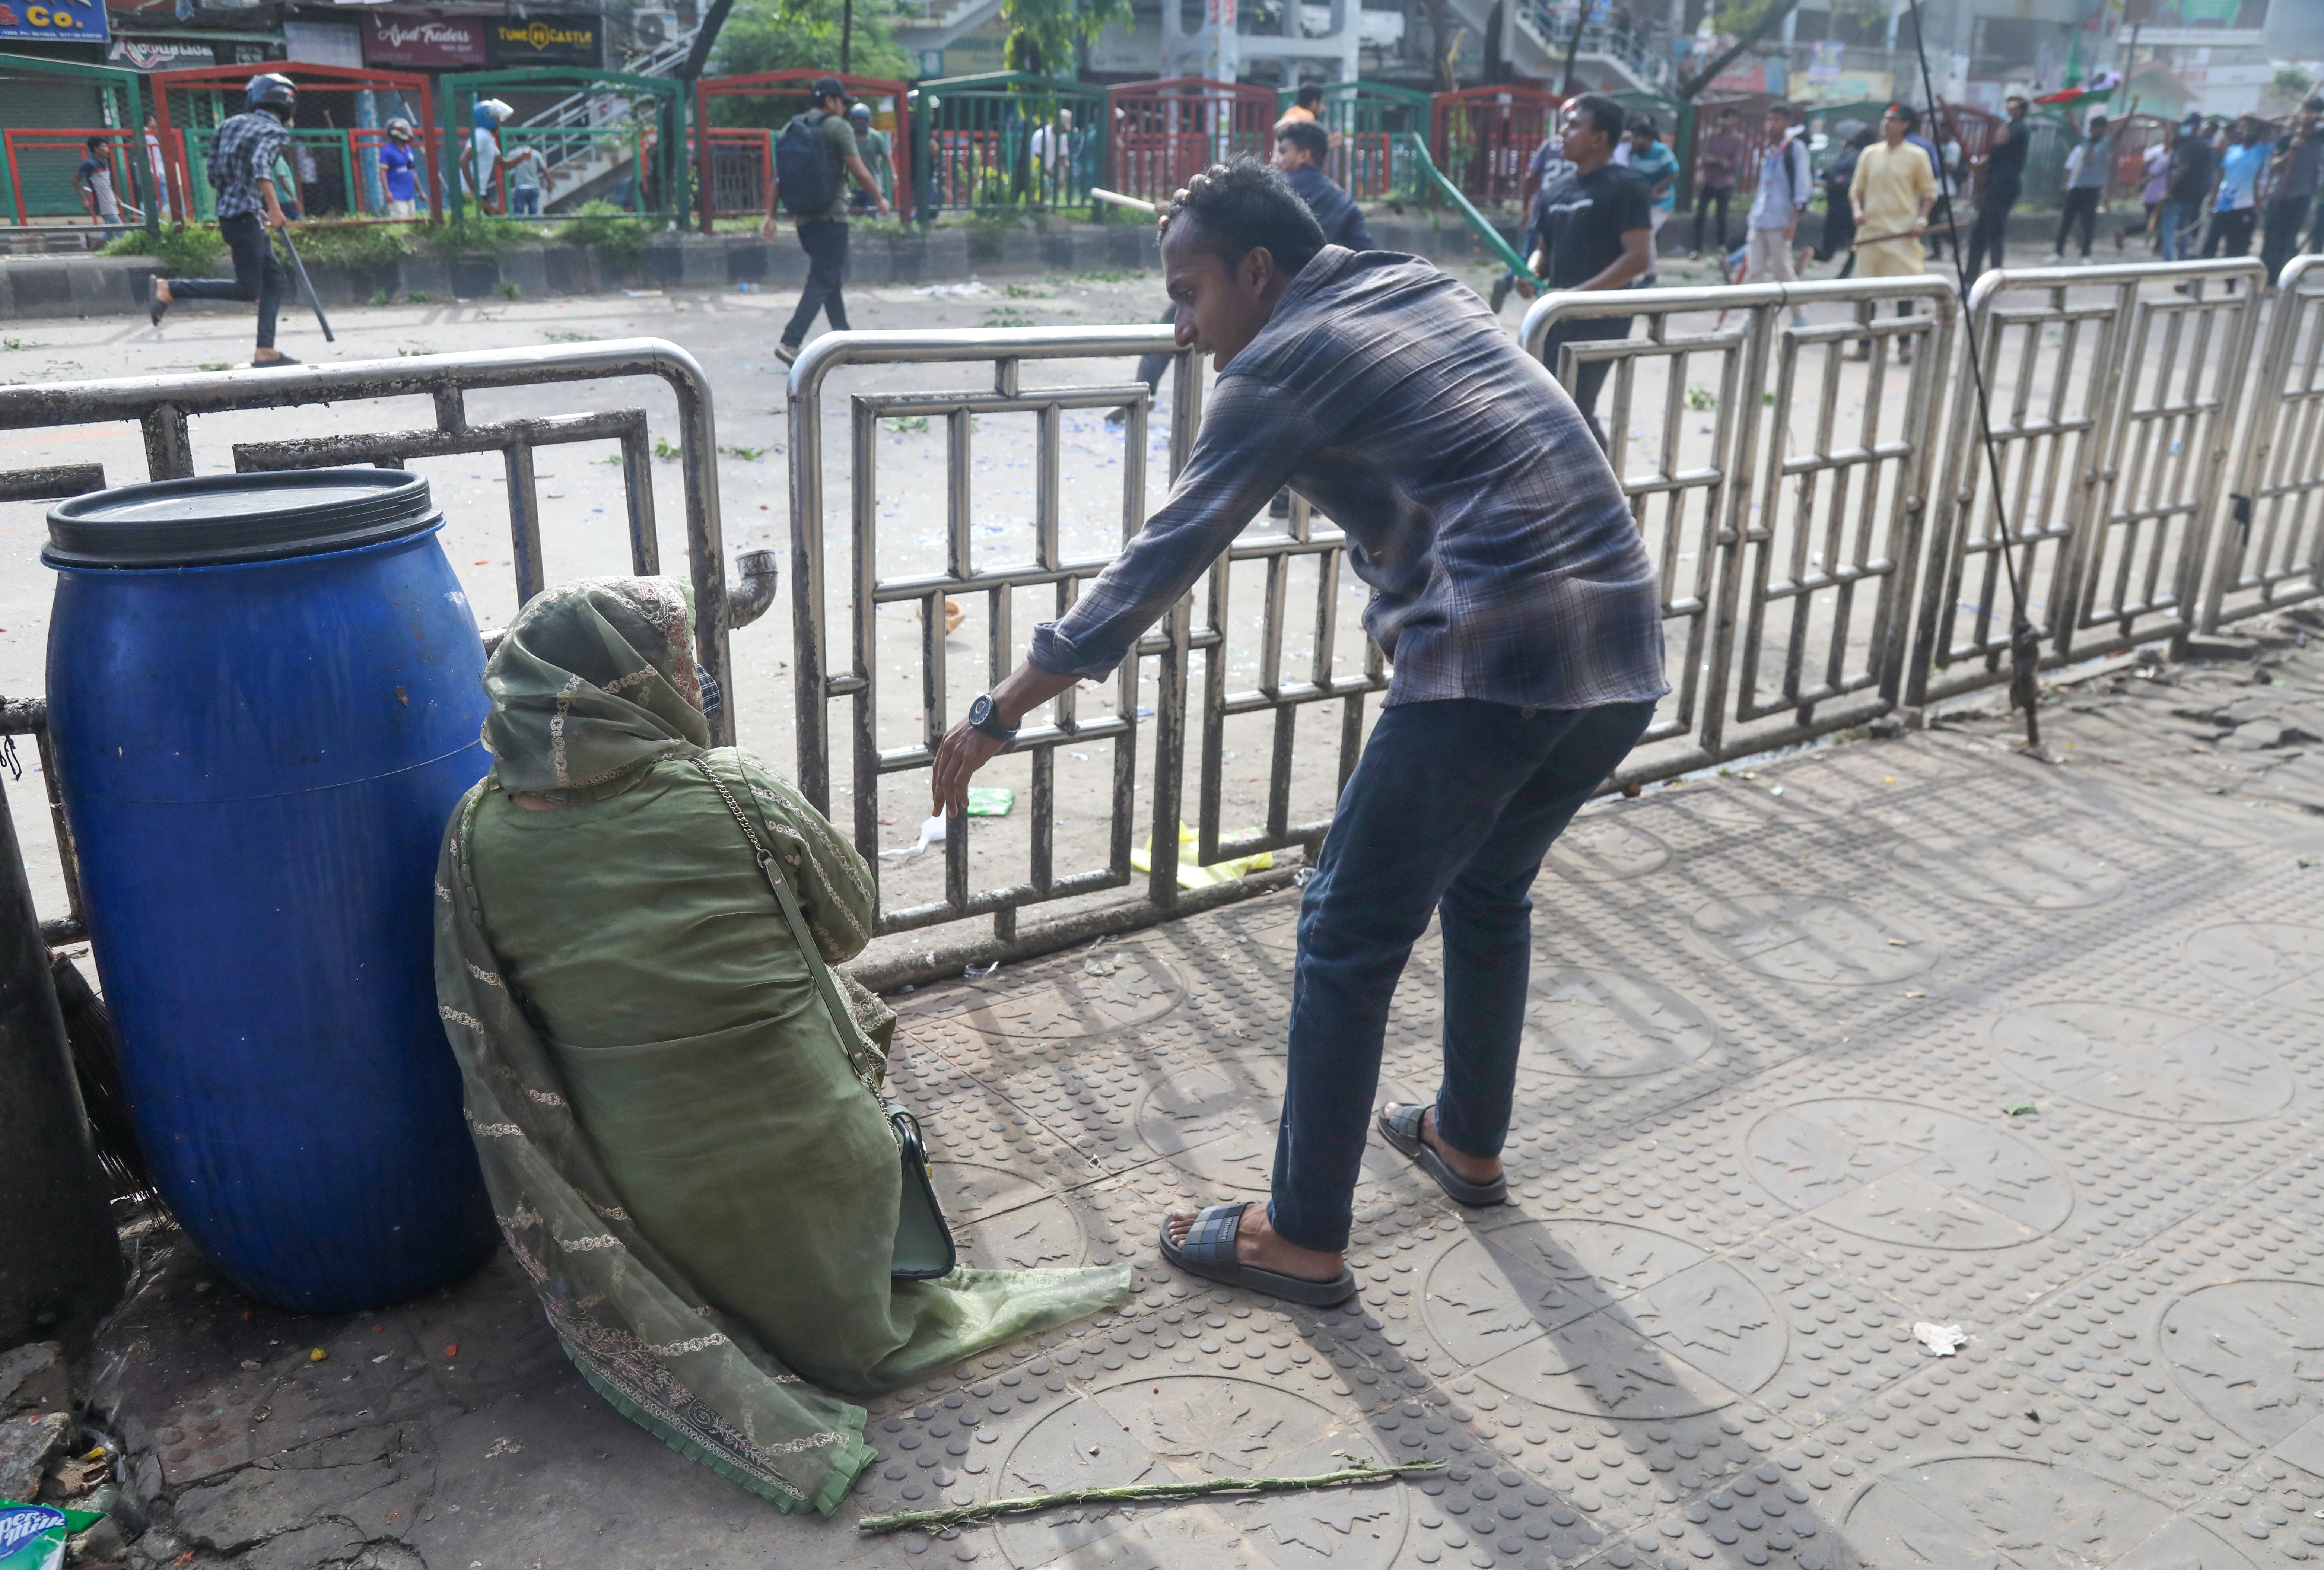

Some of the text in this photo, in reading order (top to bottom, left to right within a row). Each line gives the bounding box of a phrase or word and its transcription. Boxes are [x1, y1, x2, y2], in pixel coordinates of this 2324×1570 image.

[0, 4, 83, 28] & Co.
[549, 29, 594, 43] CASTLE
[1221, 1217, 1233, 1240] Winner
[4, 1516, 66, 1547] Milk
